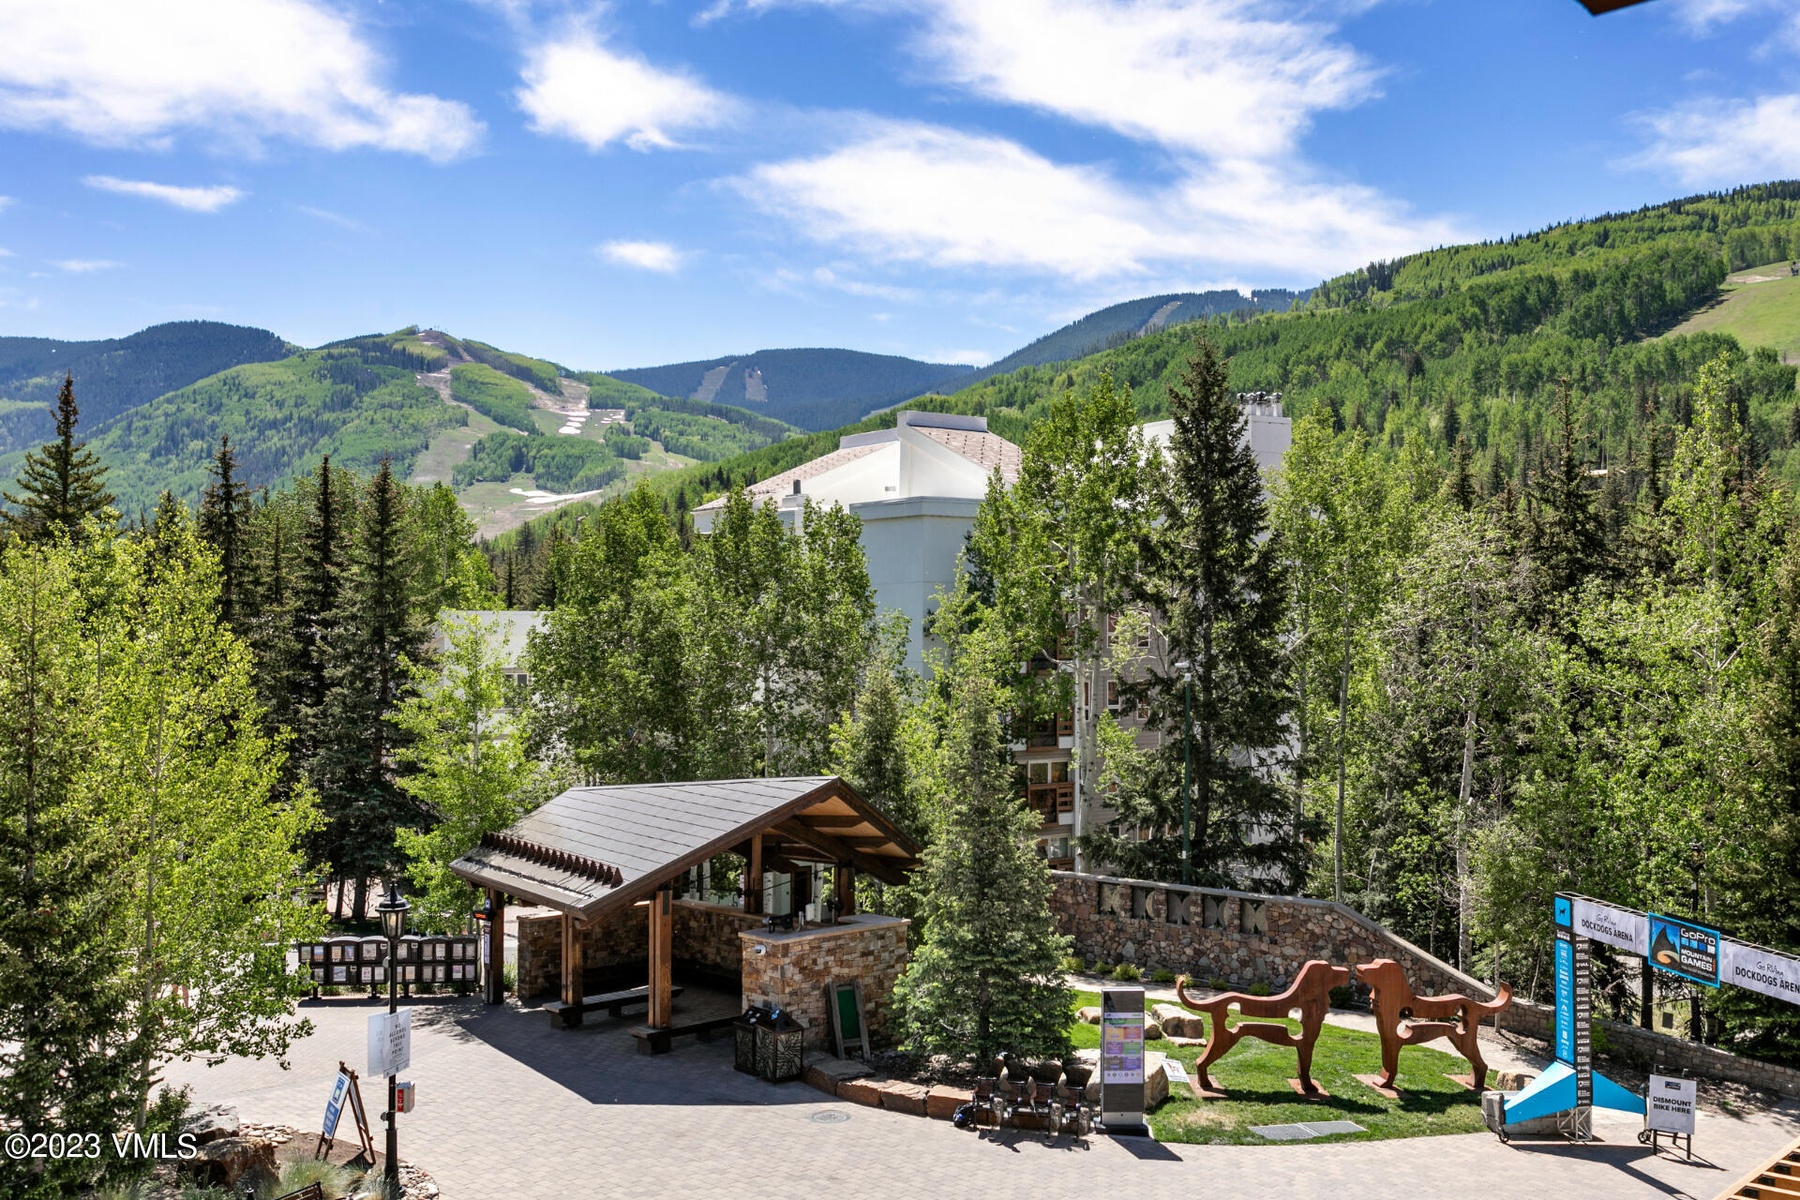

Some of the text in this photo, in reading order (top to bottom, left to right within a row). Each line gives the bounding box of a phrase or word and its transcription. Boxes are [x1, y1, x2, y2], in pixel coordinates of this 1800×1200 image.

[1581, 919, 1613, 936] DOCKDOGS
[1613, 929, 1634, 942] ARENA
[1681, 948, 1713, 963] MOUNTAIN
[1681, 955, 1713, 972] GAMES
[1756, 961, 1765, 971] Go
[1735, 966, 1778, 987] DOCKDOGS
[1653, 1096, 1692, 1107] DISMOUNT
[1653, 1103, 1691, 1114] BIKE HERE
